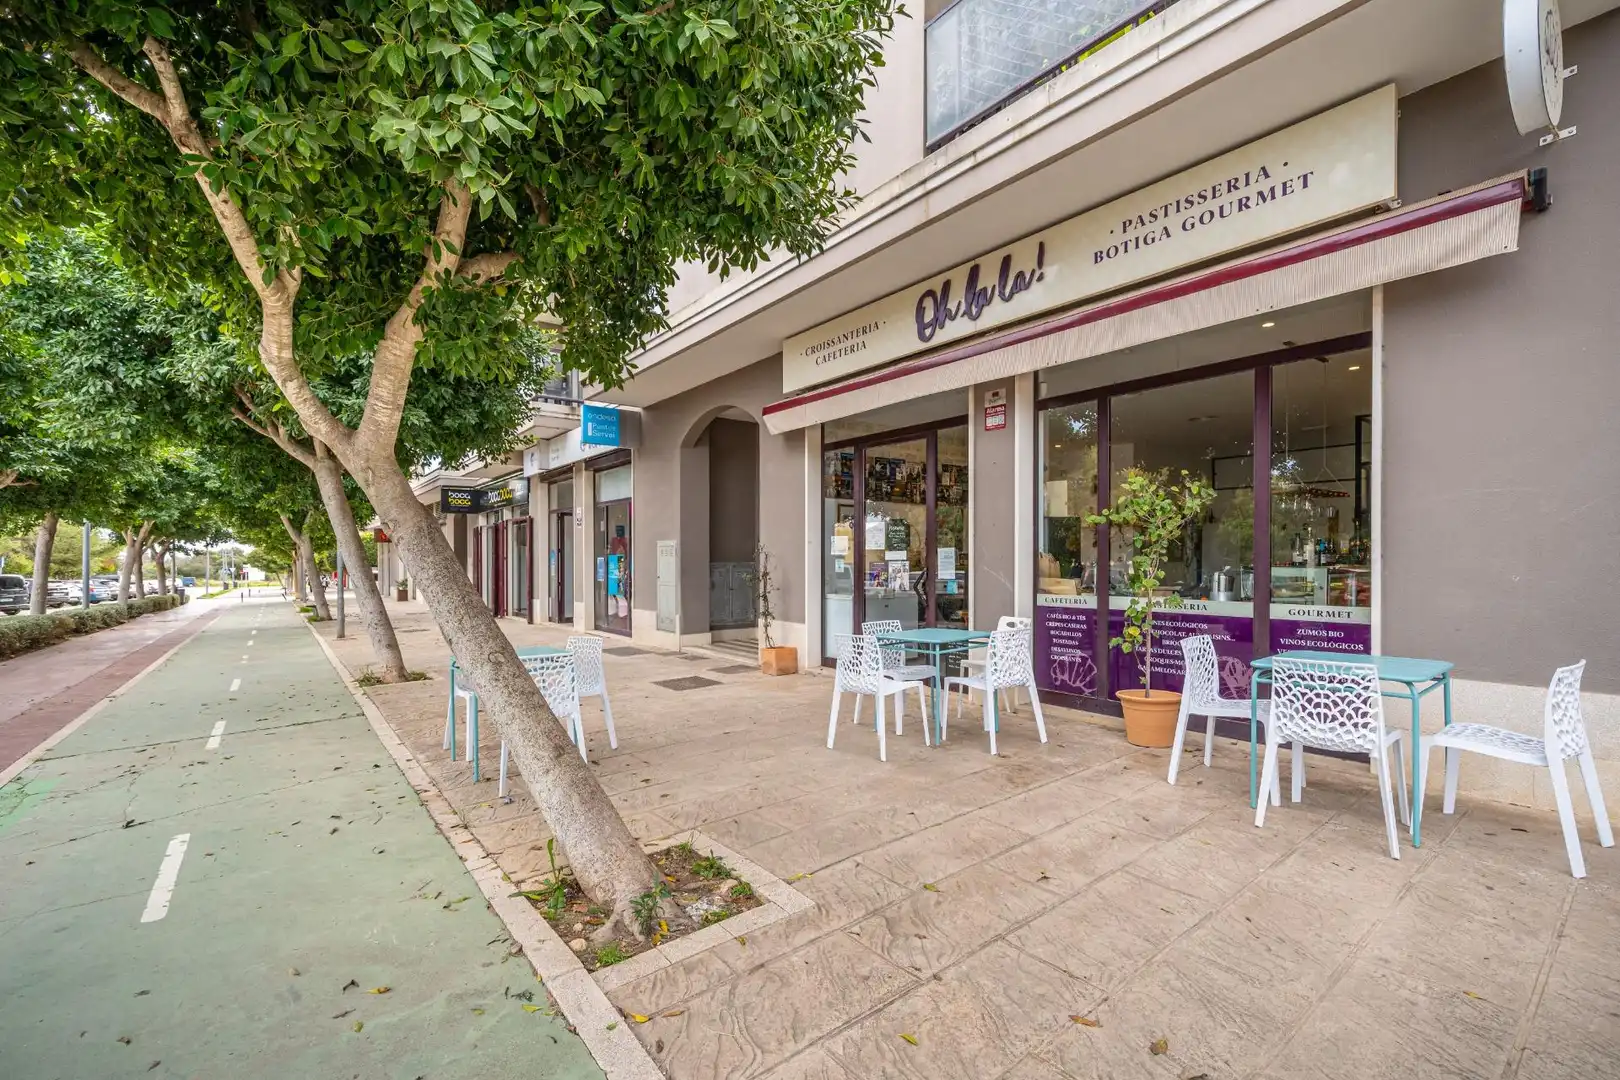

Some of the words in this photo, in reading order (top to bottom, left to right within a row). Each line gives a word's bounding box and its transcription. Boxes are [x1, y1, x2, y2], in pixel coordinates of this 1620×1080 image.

[1122, 165, 1271, 234] PASTISSERIA
[1093, 226, 1172, 265] BOTIGA
[1181, 171, 1315, 233] GOURMET
[915, 278, 961, 343] Oh
[805, 321, 880, 357] CROISSANTERIA
[815, 340, 867, 366] CAFETERIA
[1044, 597, 1088, 605] CAFETERIA
[1288, 608, 1353, 619] GOURMET
[1280, 638, 1306, 646] VINOS
[1307, 640, 1364, 651] ECOLÓGICOS
[1296, 628, 1327, 637] ZUMOS
